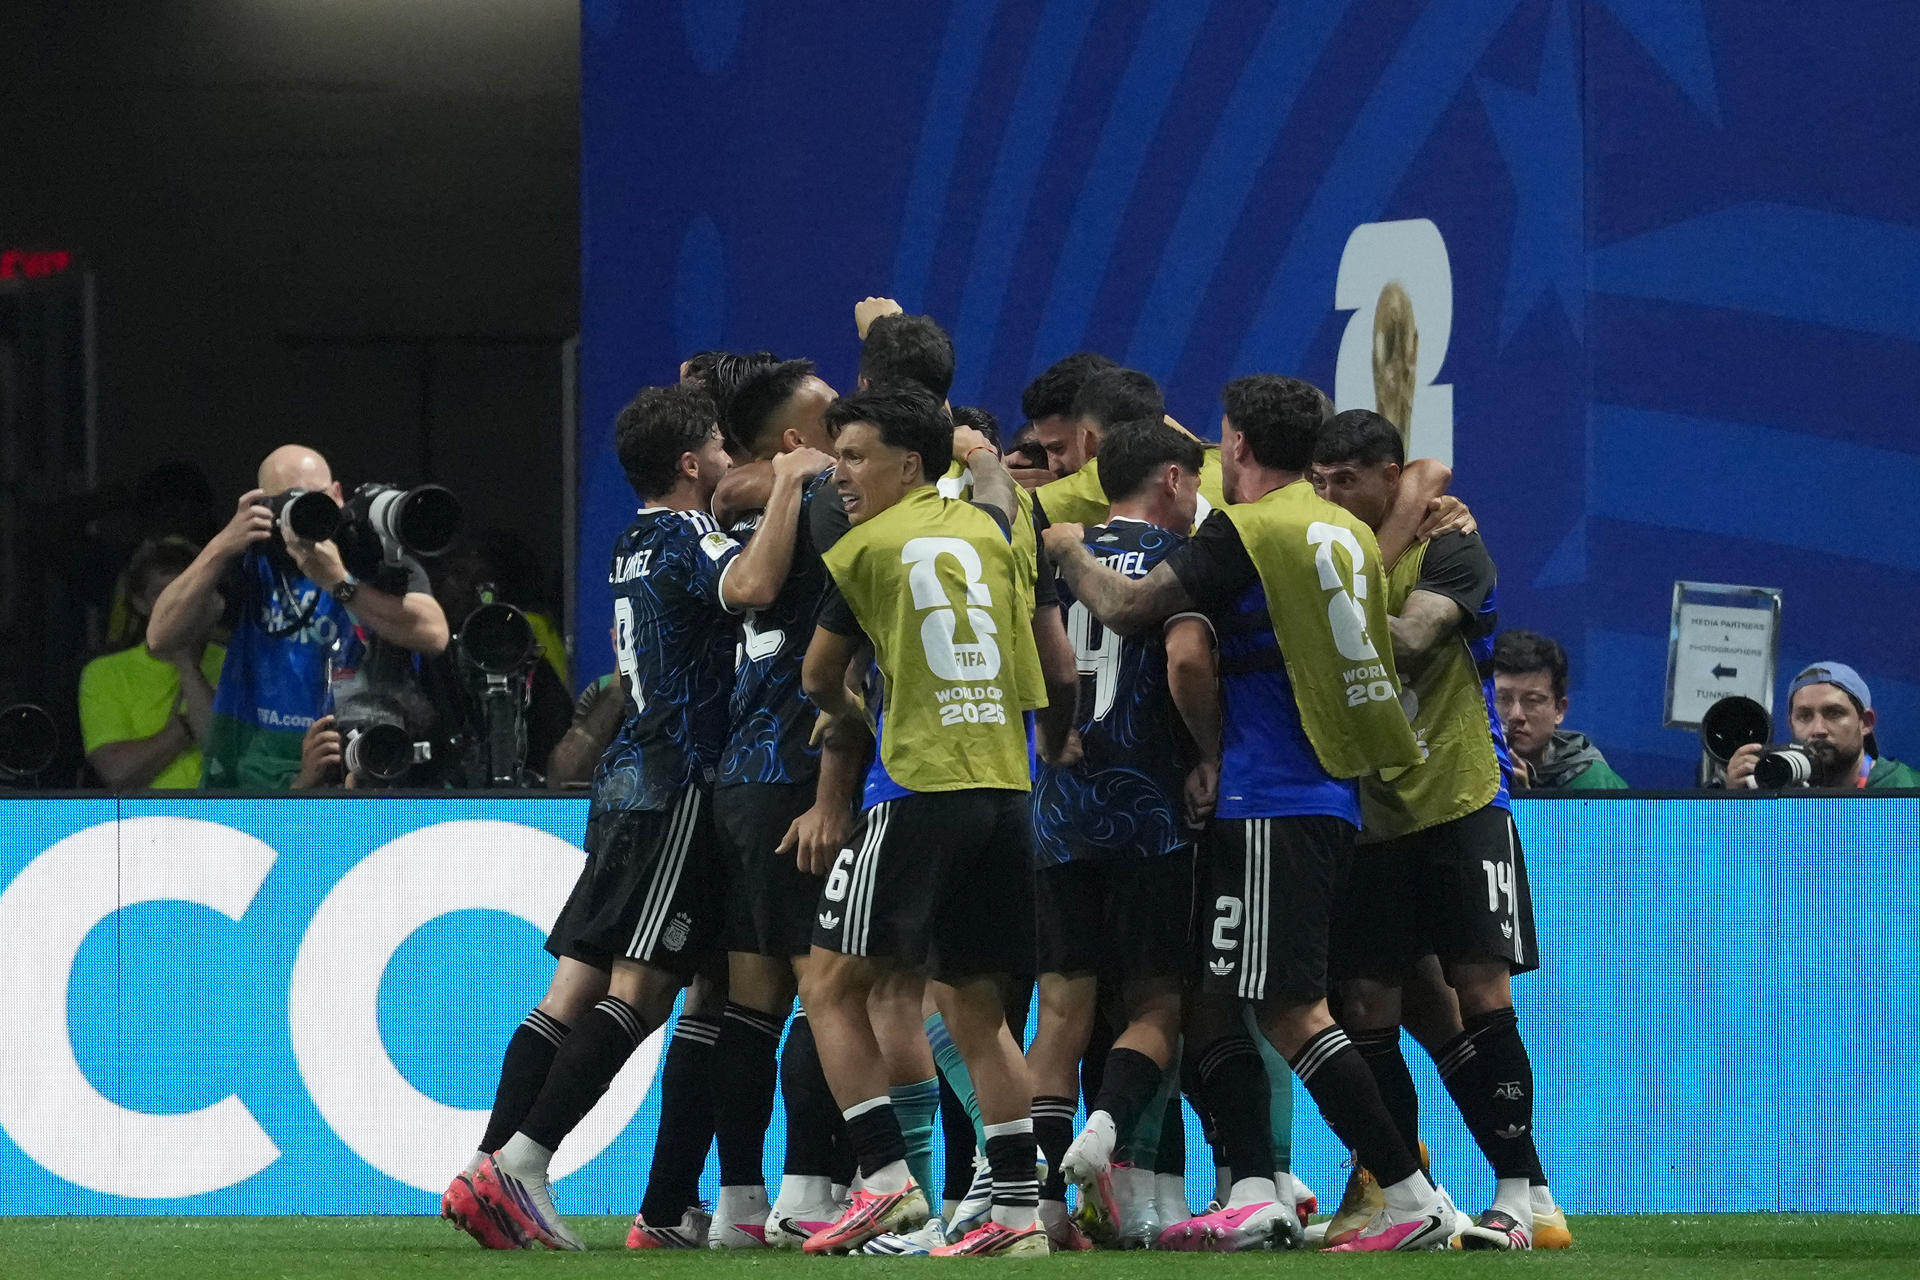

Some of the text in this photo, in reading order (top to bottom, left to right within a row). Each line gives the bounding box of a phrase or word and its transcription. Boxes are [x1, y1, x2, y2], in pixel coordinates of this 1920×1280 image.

[1691, 618, 1765, 631] MEDIA PARTNERS
[614, 597, 646, 714] 9
[953, 651, 987, 667] FIFA
[1067, 600, 1124, 722] 4
[986, 686, 1003, 701] CP
[1695, 689, 1734, 700] TUNNE
[939, 702, 1006, 726] 2026
[824, 848, 854, 902] 6
[1482, 859, 1513, 915] 14
[1211, 895, 1243, 951] 2
